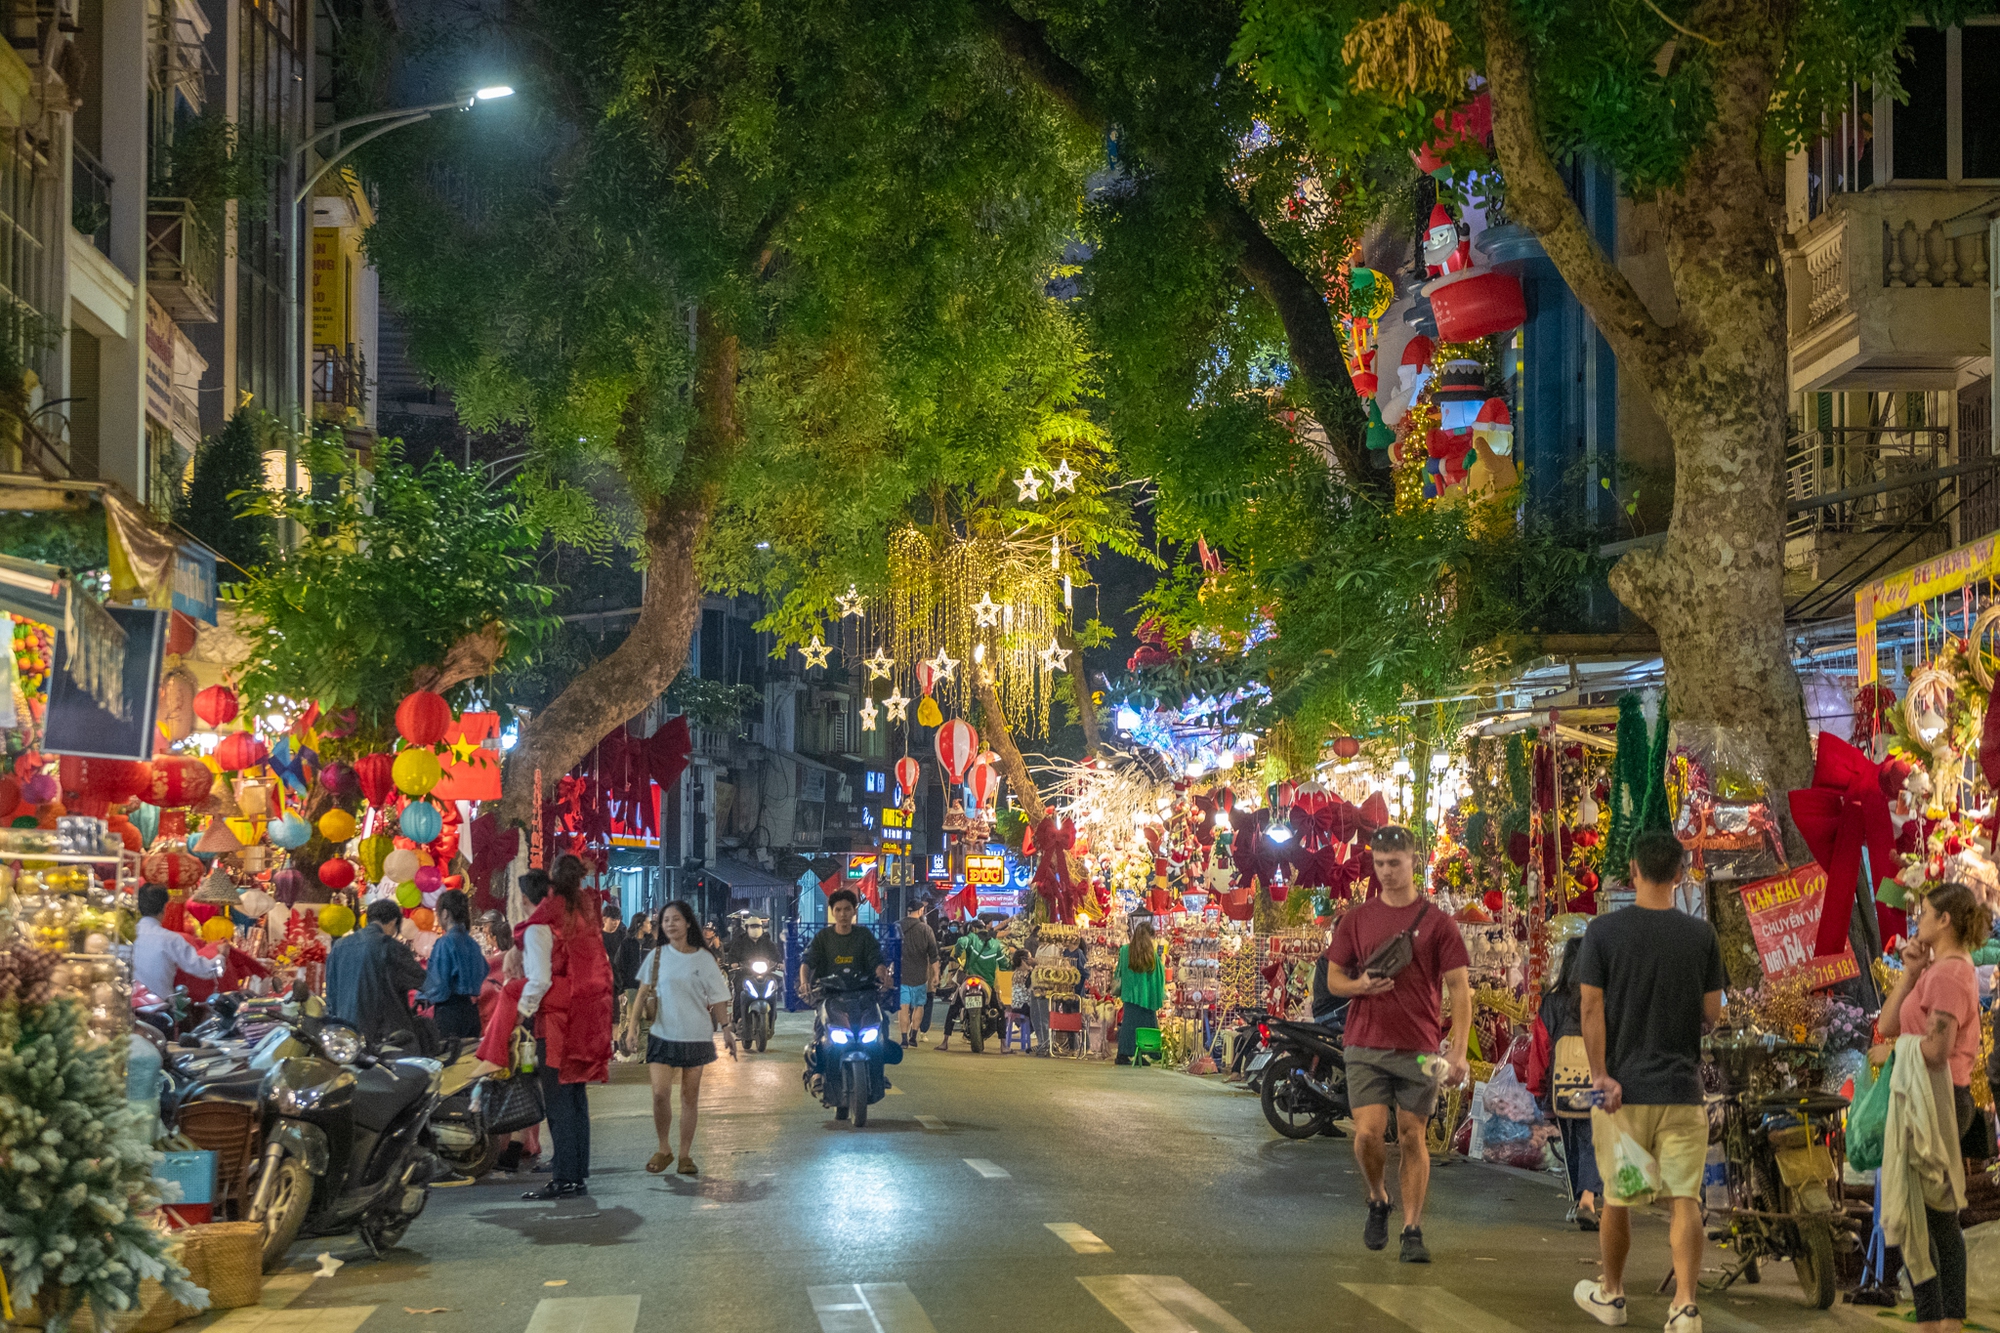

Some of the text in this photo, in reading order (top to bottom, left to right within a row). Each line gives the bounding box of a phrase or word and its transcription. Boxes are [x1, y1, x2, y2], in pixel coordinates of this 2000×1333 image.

[1746, 886, 1775, 914] LAN
[1761, 908, 1806, 938] CHUYỂN
[1782, 932, 1807, 967] 64
[1836, 957, 1856, 977] 181
